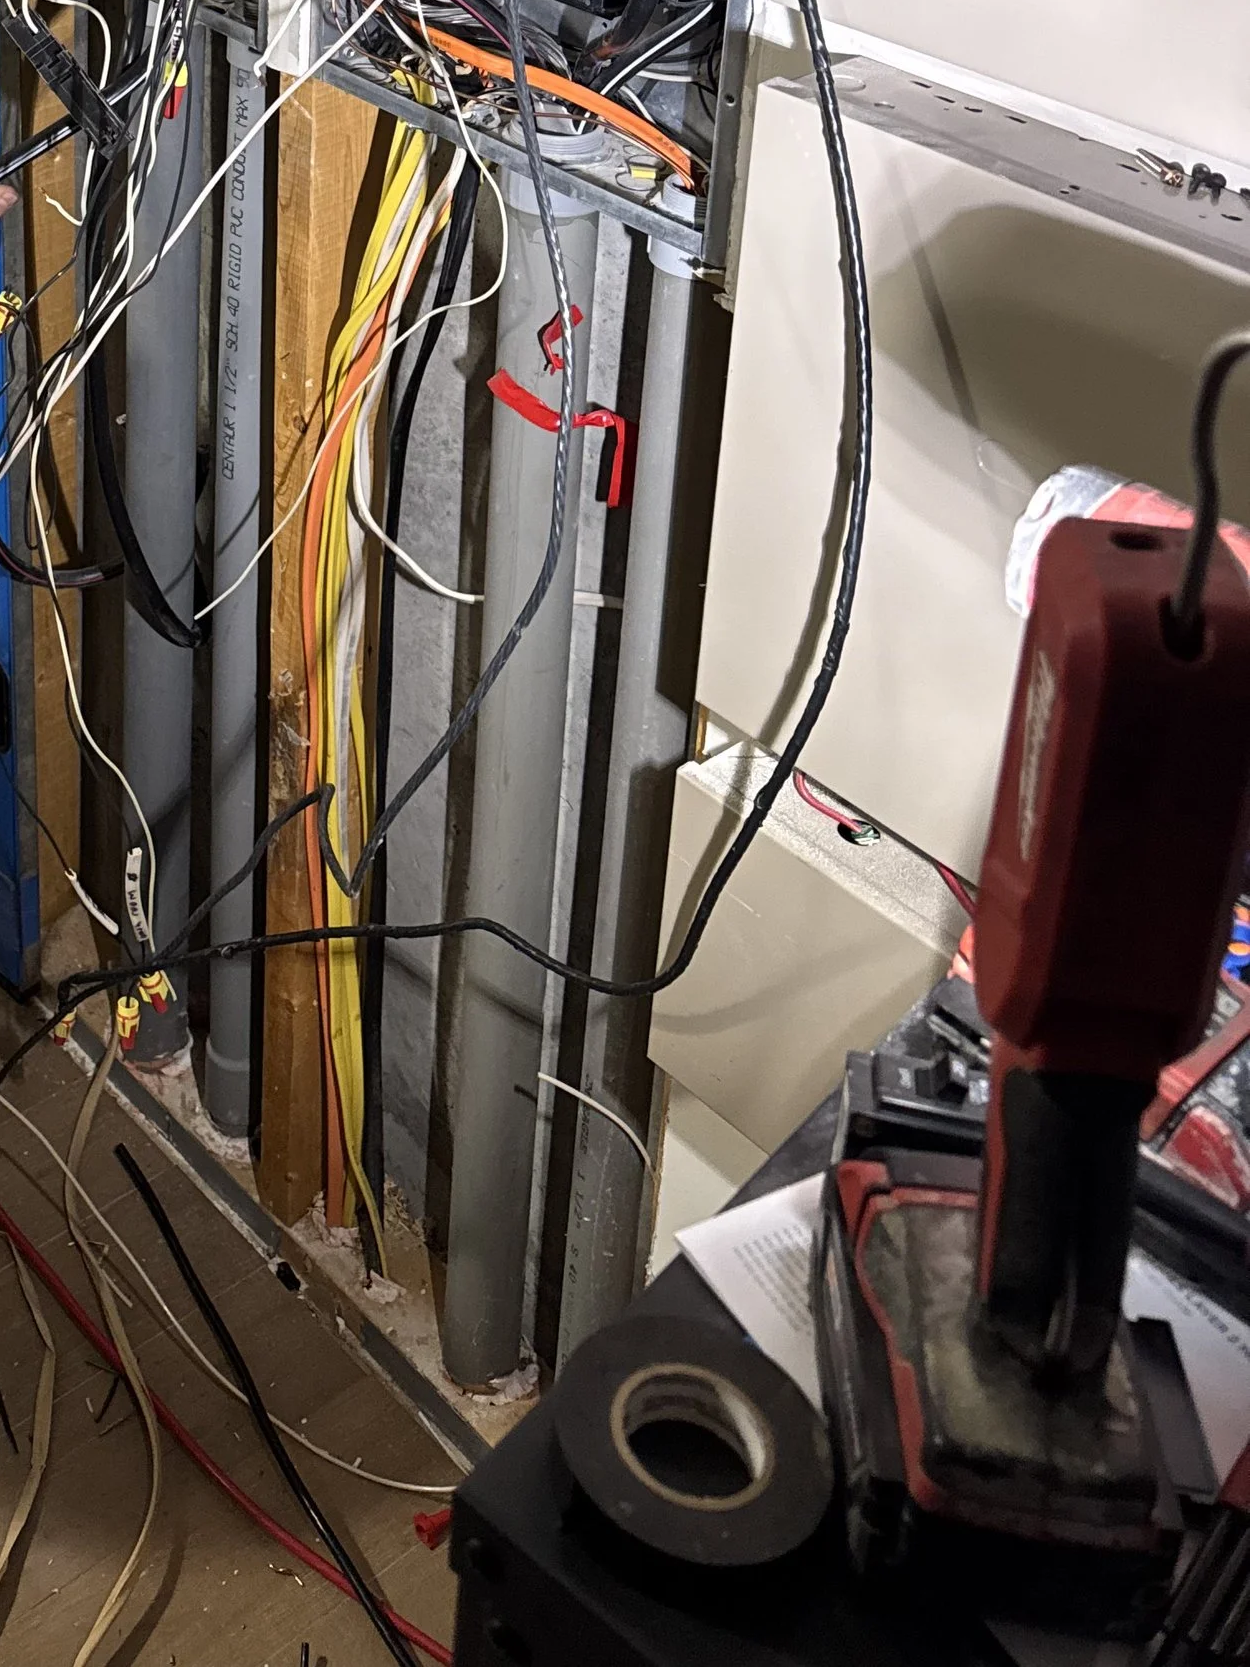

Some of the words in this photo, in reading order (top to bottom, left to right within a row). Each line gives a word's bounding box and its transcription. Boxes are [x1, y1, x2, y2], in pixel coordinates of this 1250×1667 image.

[234, 97, 249, 128] MAX
[230, 206, 244, 238] PVC
[228, 242, 243, 291] RIGID
[226, 297, 240, 318] 40
[221, 419, 237, 481] CENTAUR
